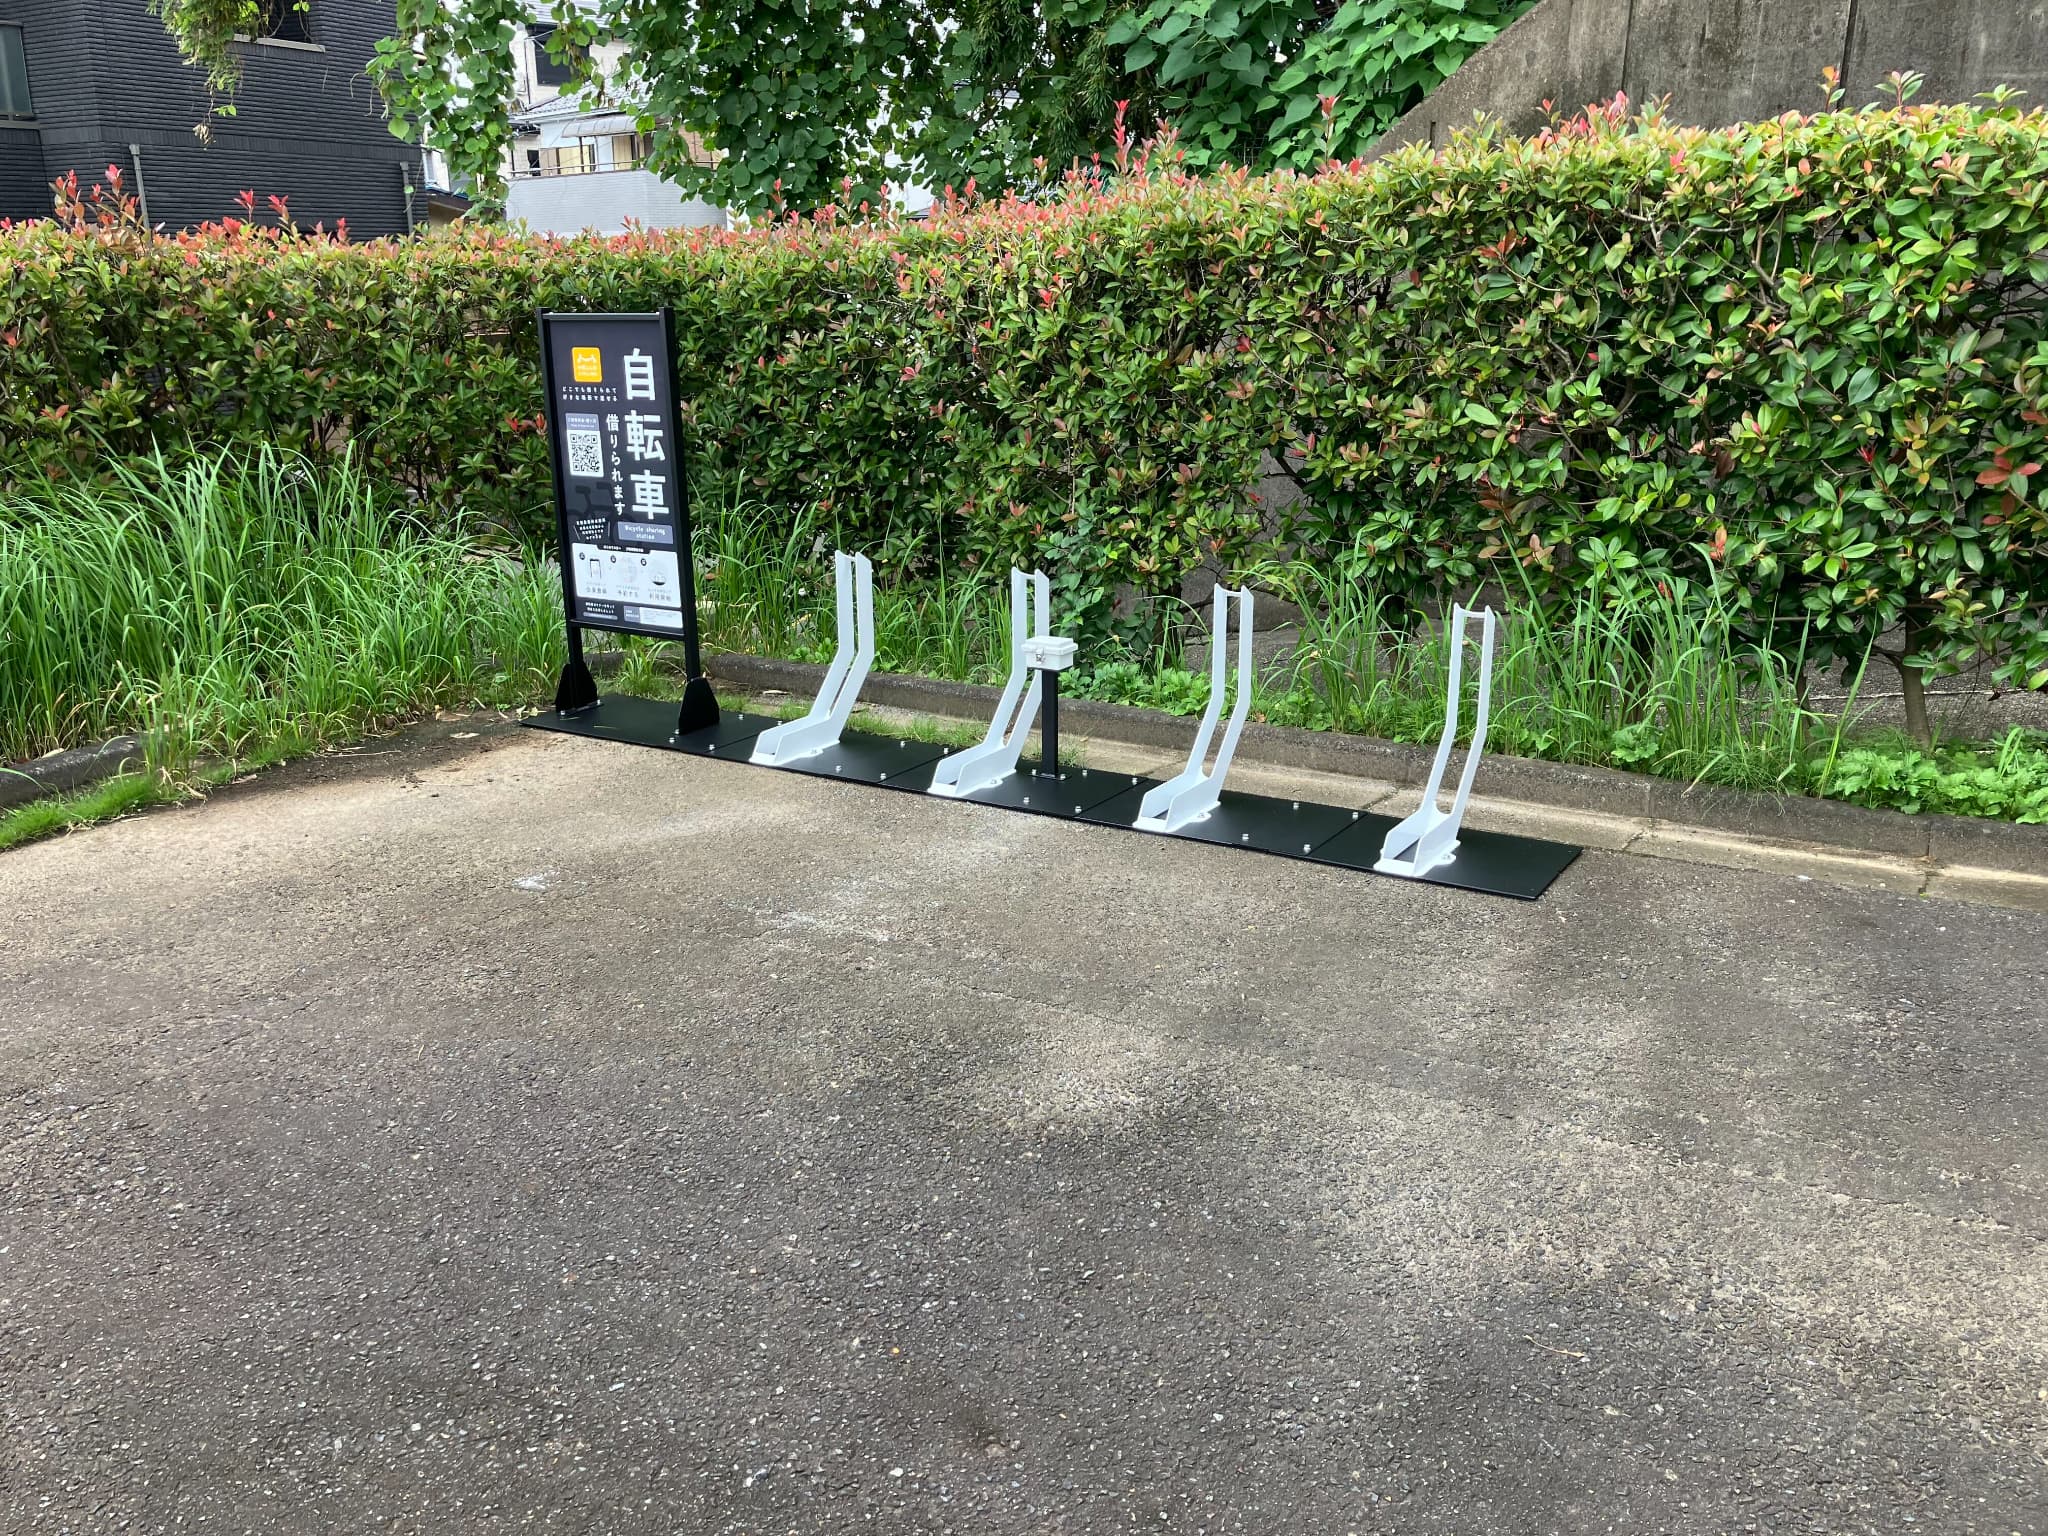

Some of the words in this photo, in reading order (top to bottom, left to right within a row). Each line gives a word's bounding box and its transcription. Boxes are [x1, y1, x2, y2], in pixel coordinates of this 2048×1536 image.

[606, 413, 626, 516] 借りられます
[623, 348, 669, 520] 自転車
